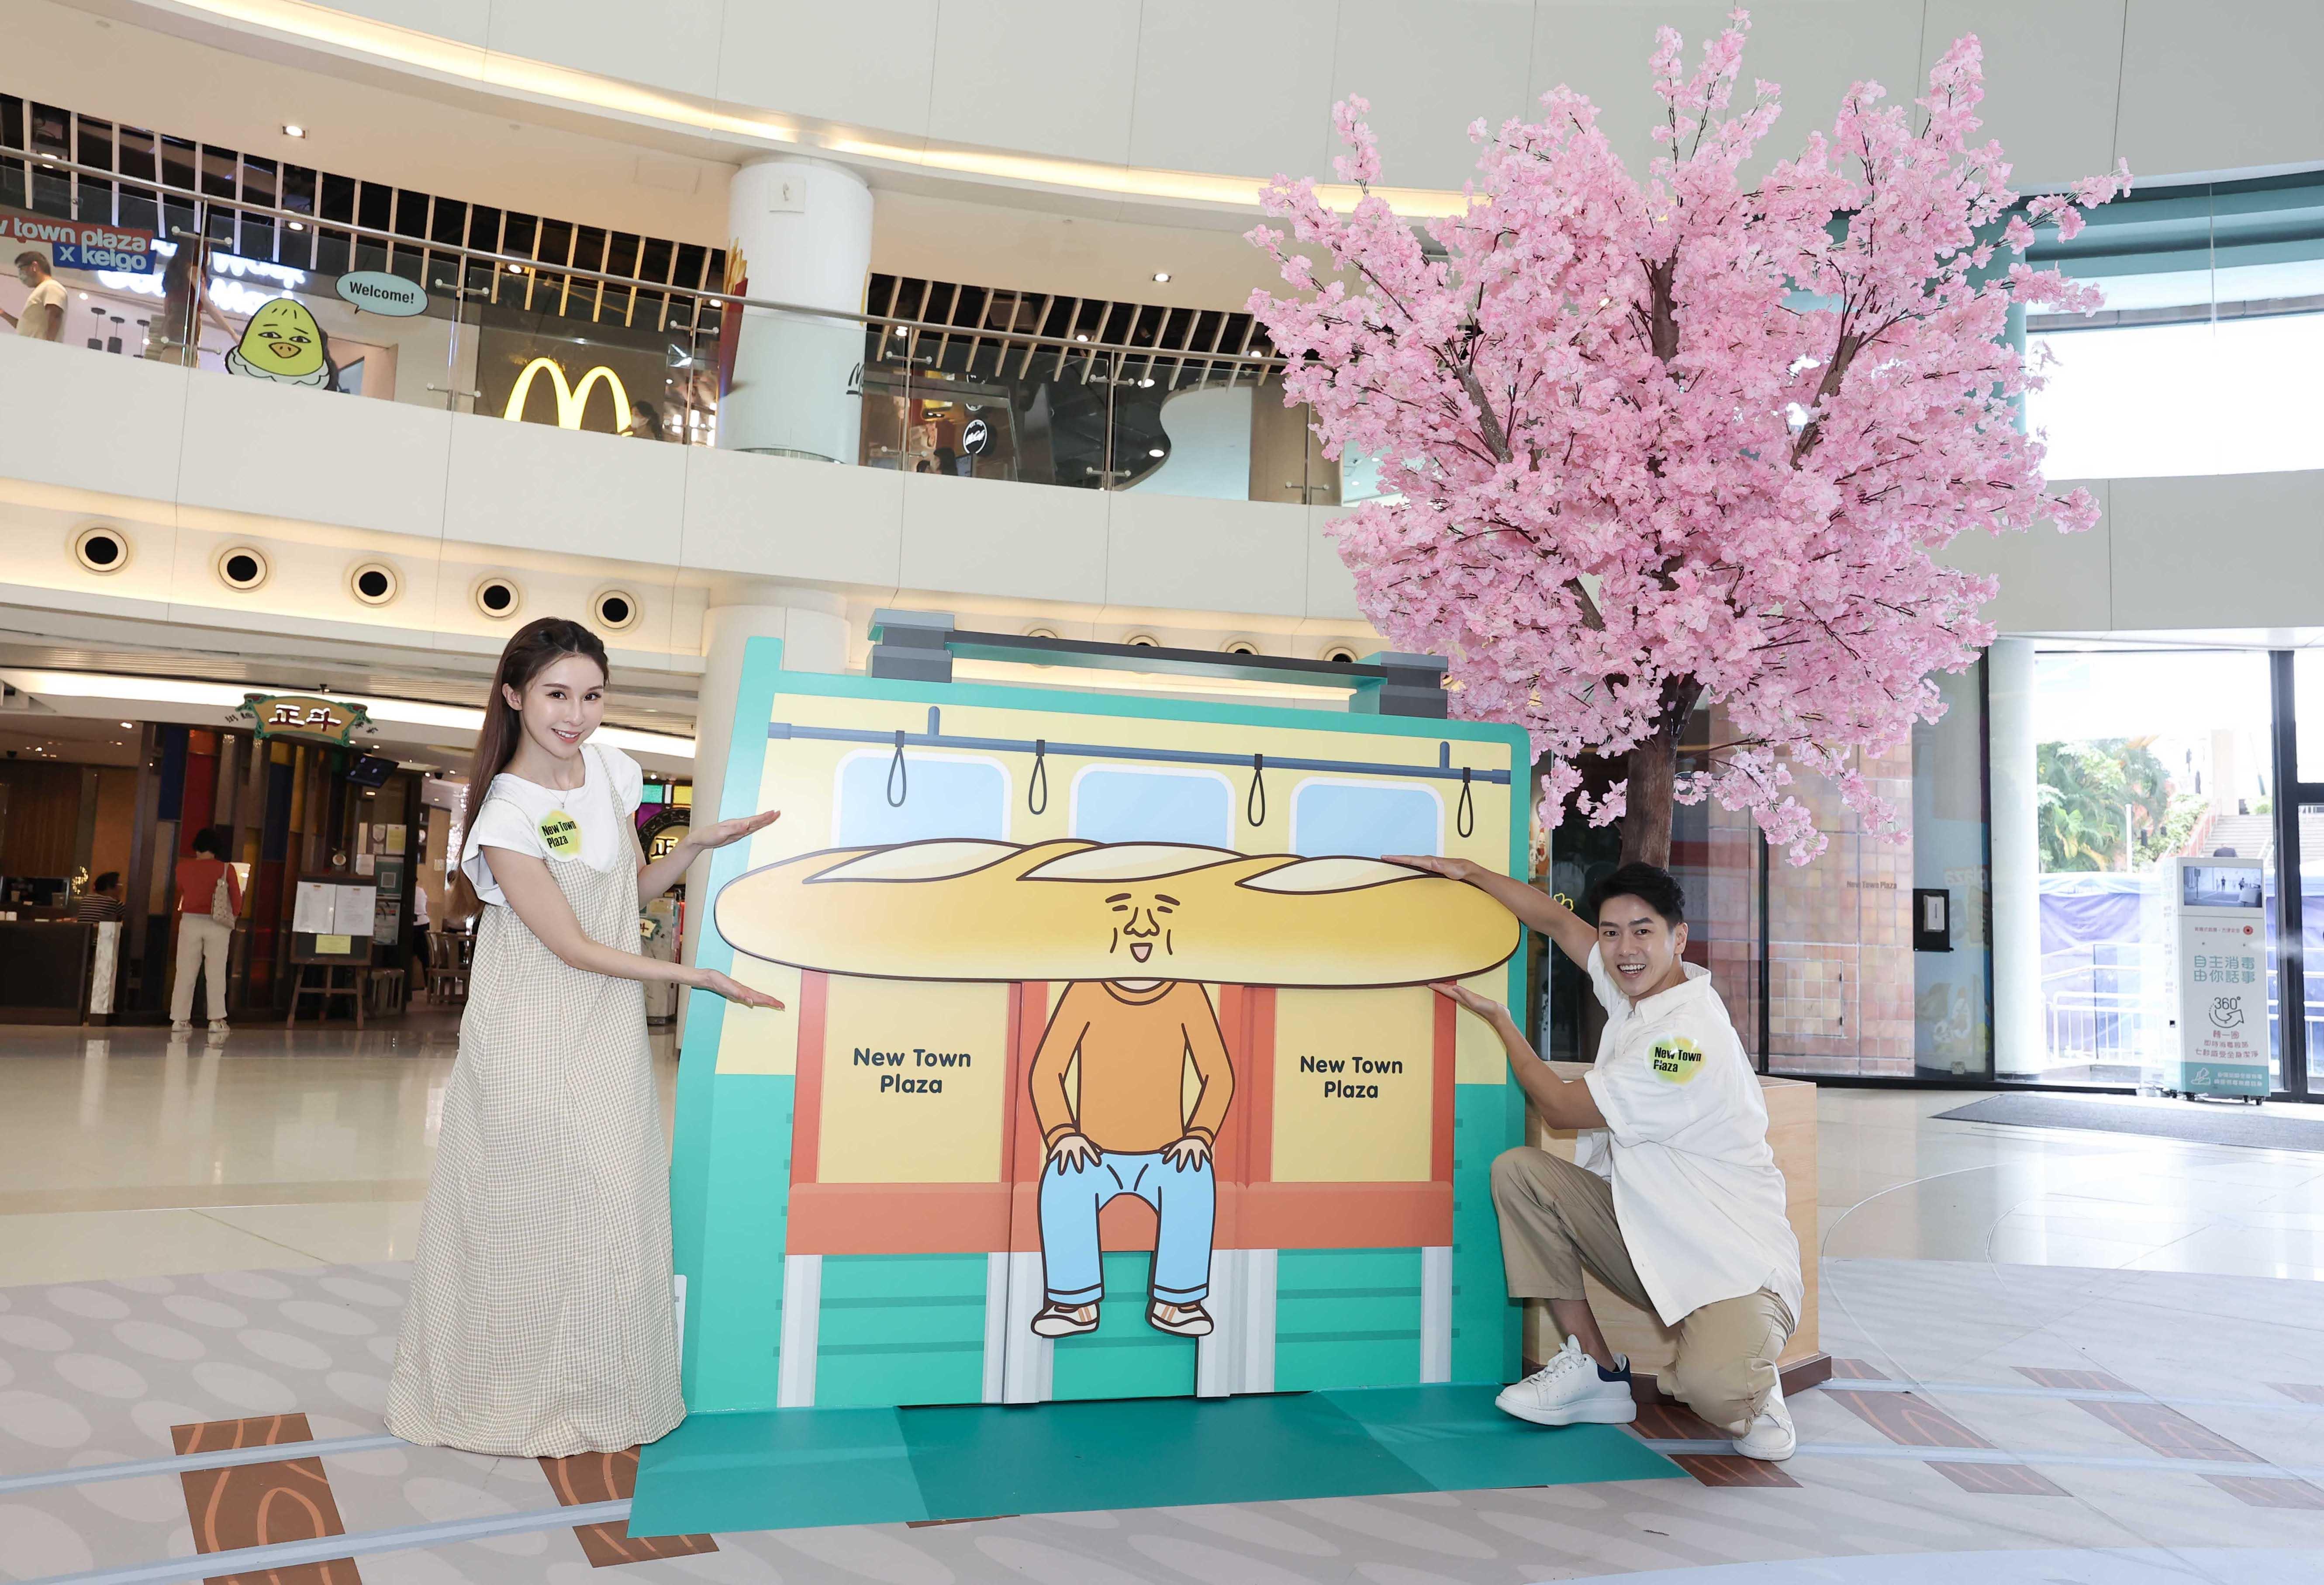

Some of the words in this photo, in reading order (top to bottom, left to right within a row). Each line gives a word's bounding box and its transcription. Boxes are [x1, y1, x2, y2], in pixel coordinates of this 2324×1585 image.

[14, 217, 76, 243] town
[81, 228, 146, 253] plaza
[82, 248, 147, 273] keigo
[349, 281, 414, 304] Welcome!
[268, 704, 342, 732] 正斗
[542, 825, 559, 836] New
[558, 821, 576, 831] Town
[546, 835, 568, 848] Plaza
[2194, 955, 2255, 970] 自主消毒
[2194, 969, 2255, 984] 由你話事
[2214, 996, 2241, 1010] 360°
[853, 1048, 905, 1066] New
[913, 1049, 971, 1067] Town
[1654, 1047, 1675, 1059] New
[1678, 1049, 1702, 1062] Town
[1300, 1056, 1345, 1073] New
[1352, 1056, 1403, 1074] Town
[1653, 1059, 1678, 1073] Plaza
[880, 1073, 943, 1094] Plaza
[1324, 1080, 1378, 1098] Plaza
